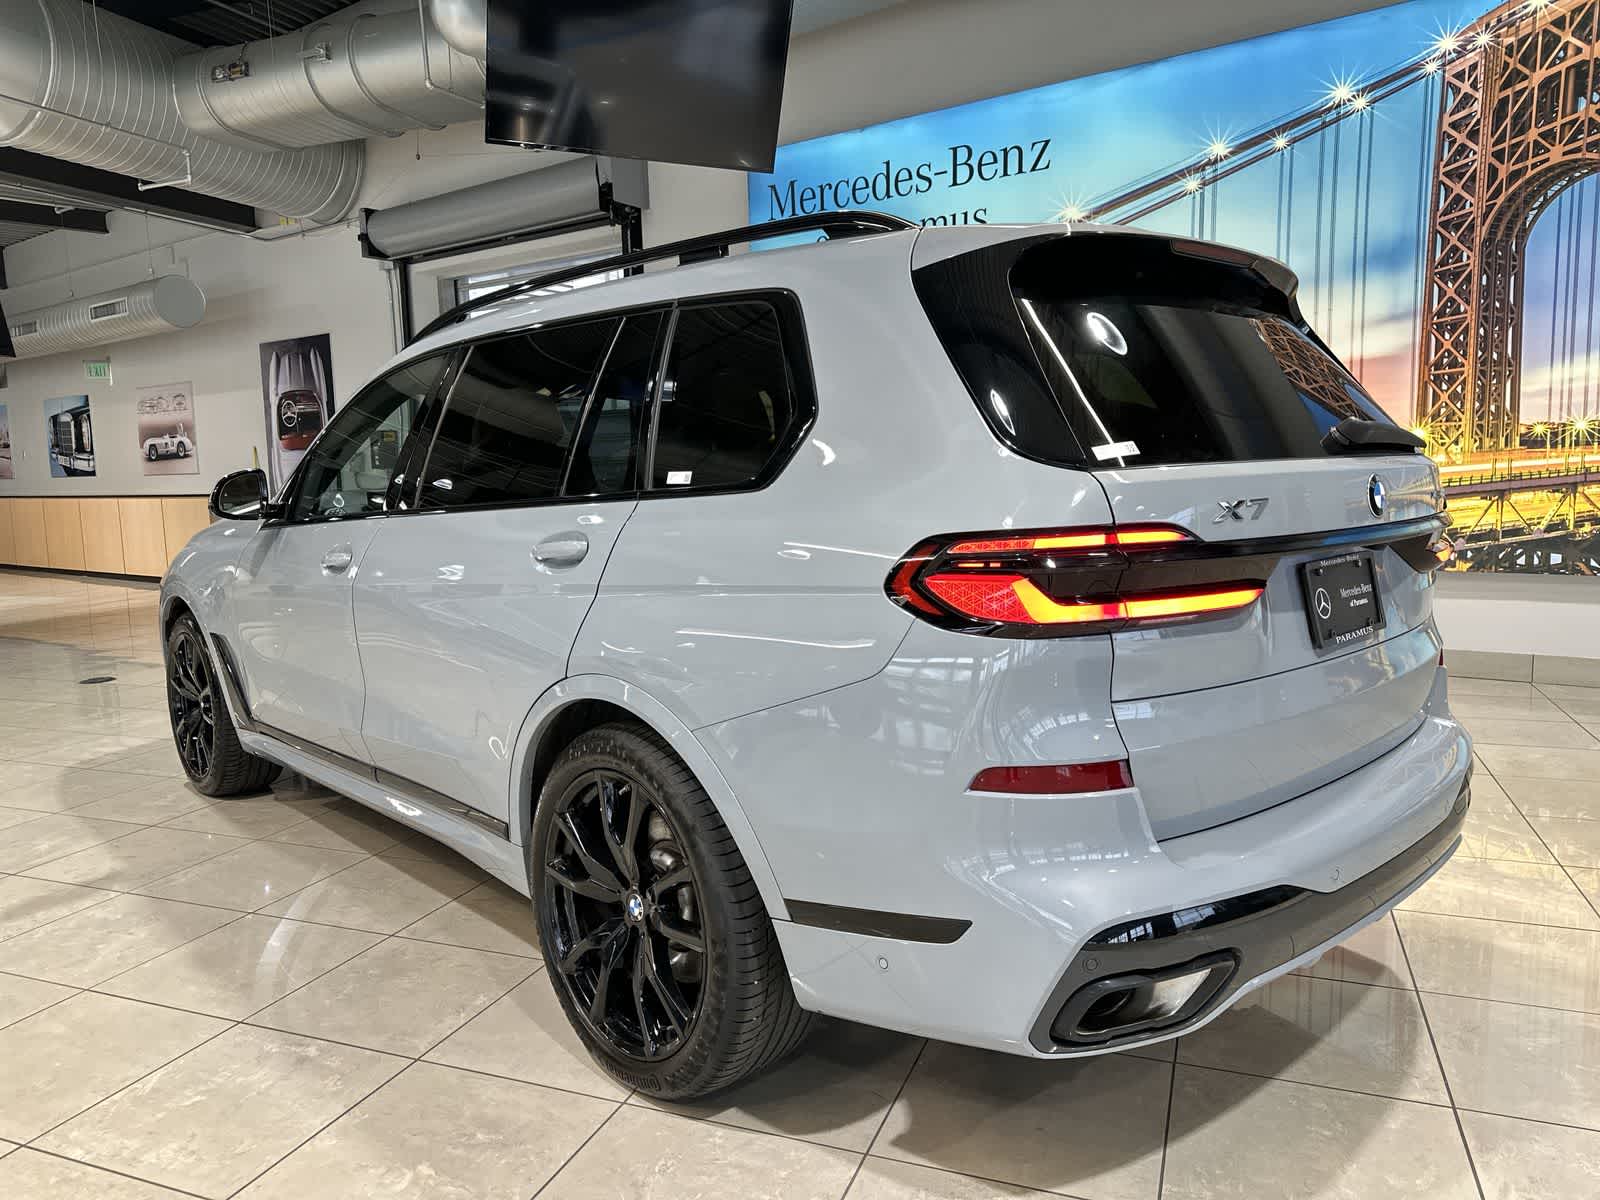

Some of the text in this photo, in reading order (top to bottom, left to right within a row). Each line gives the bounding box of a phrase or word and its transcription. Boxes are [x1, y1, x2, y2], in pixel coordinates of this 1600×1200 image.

[768, 138, 1051, 220] Mercedes-Benz
[1213, 497, 1269, 524] X7
[1336, 626, 1374, 644] PARAMUS
